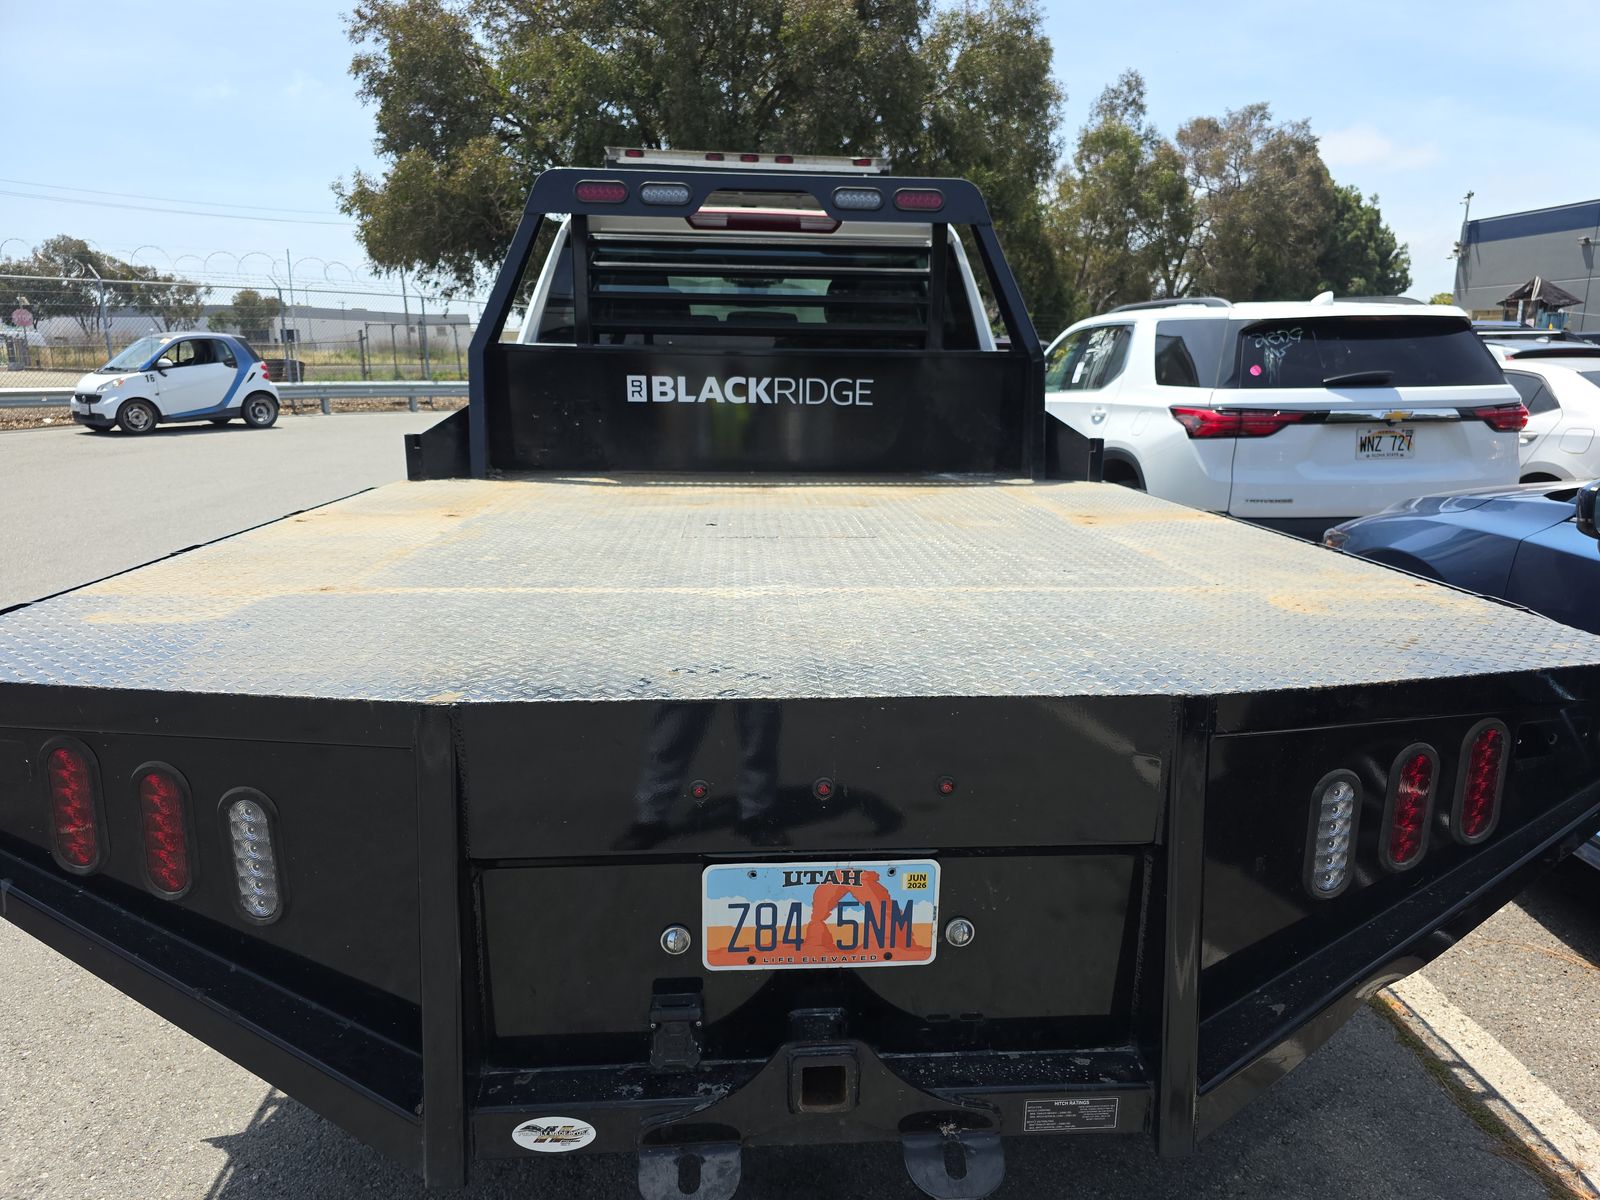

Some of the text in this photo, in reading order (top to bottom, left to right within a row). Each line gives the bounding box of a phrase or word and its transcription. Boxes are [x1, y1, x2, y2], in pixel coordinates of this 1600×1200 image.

[652, 375, 875, 406] BLACKRIDGE
[1360, 435, 1412, 452] WNZ 727
[782, 869, 863, 887] UTAH
[907, 873, 927, 882] JUN
[727, 899, 914, 953] Z84 5NM
[802, 955, 877, 963] ELEVATED
